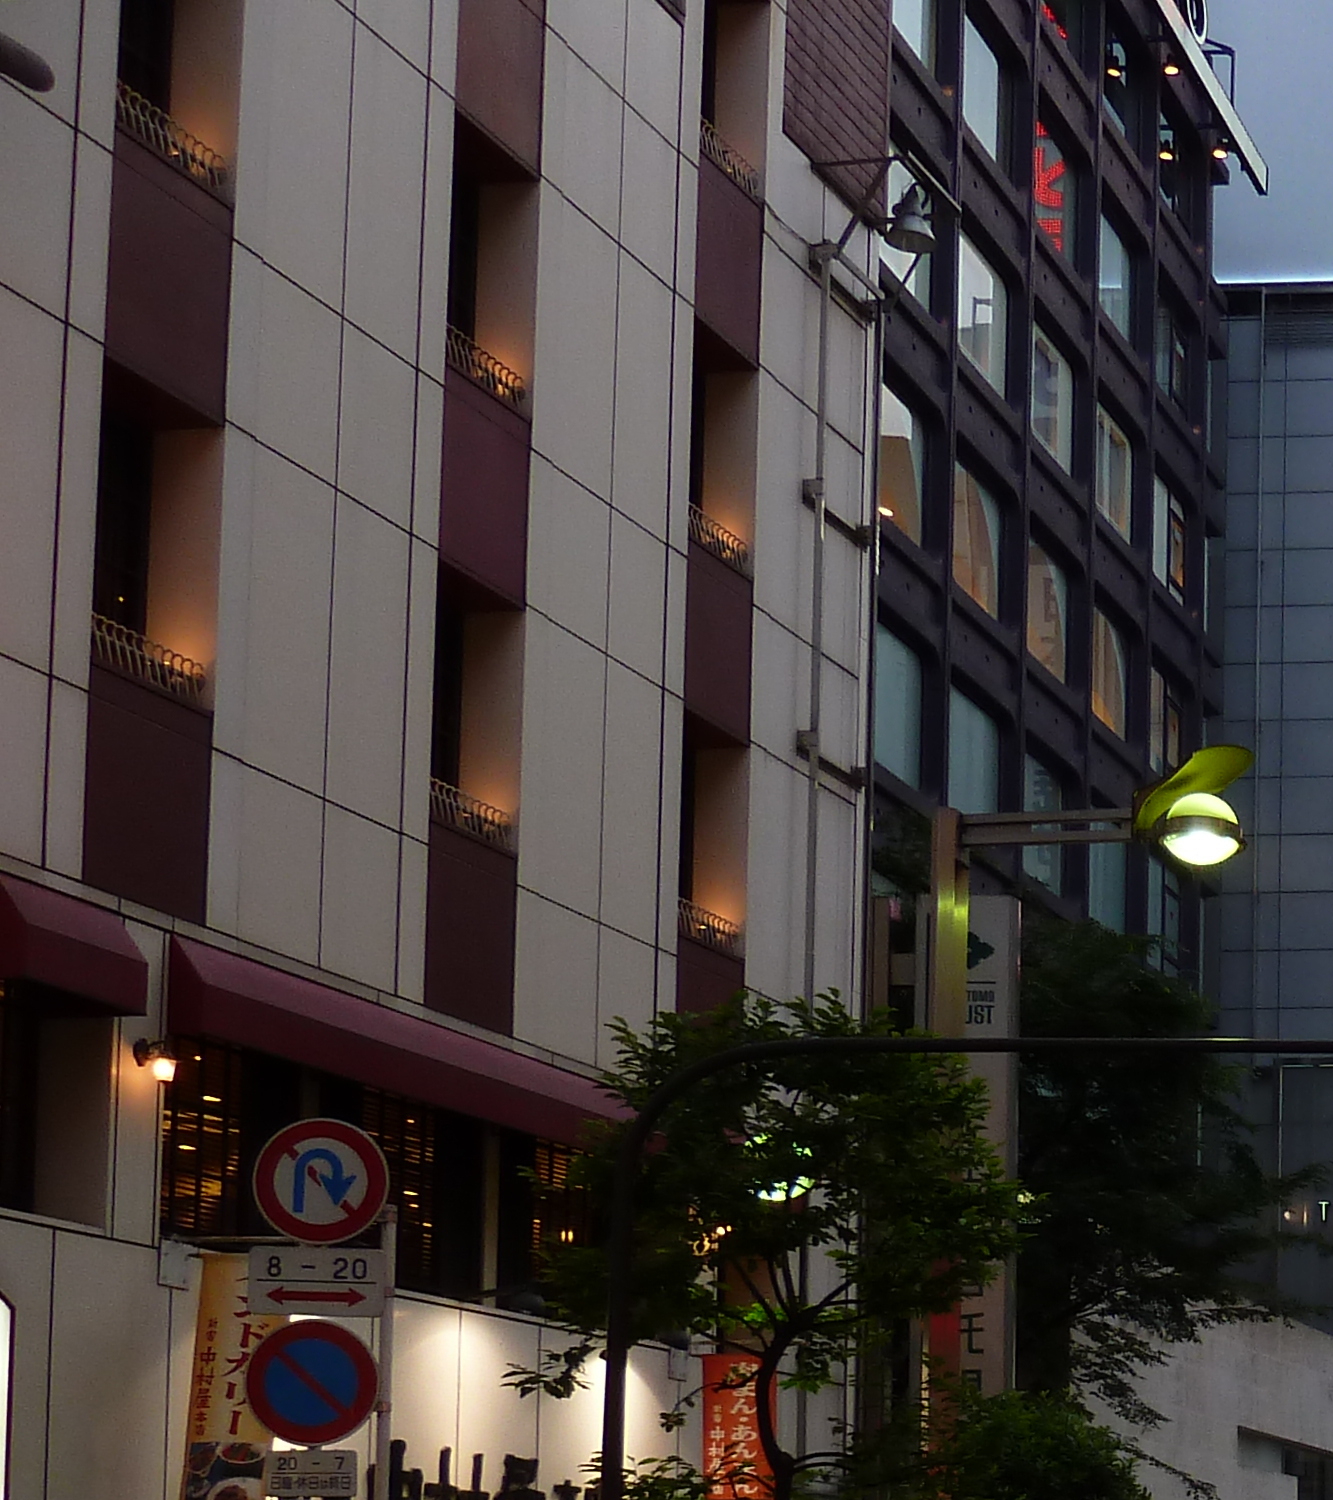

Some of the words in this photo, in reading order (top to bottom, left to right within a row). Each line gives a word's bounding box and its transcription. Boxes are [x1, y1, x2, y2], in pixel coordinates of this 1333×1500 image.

[966, 990, 995, 1003] TOMO
[267, 1255, 282, 1278] 8
[332, 1257, 368, 1280] 20
[276, 1456, 298, 1471] 20
[333, 1456, 346, 1471] 7
